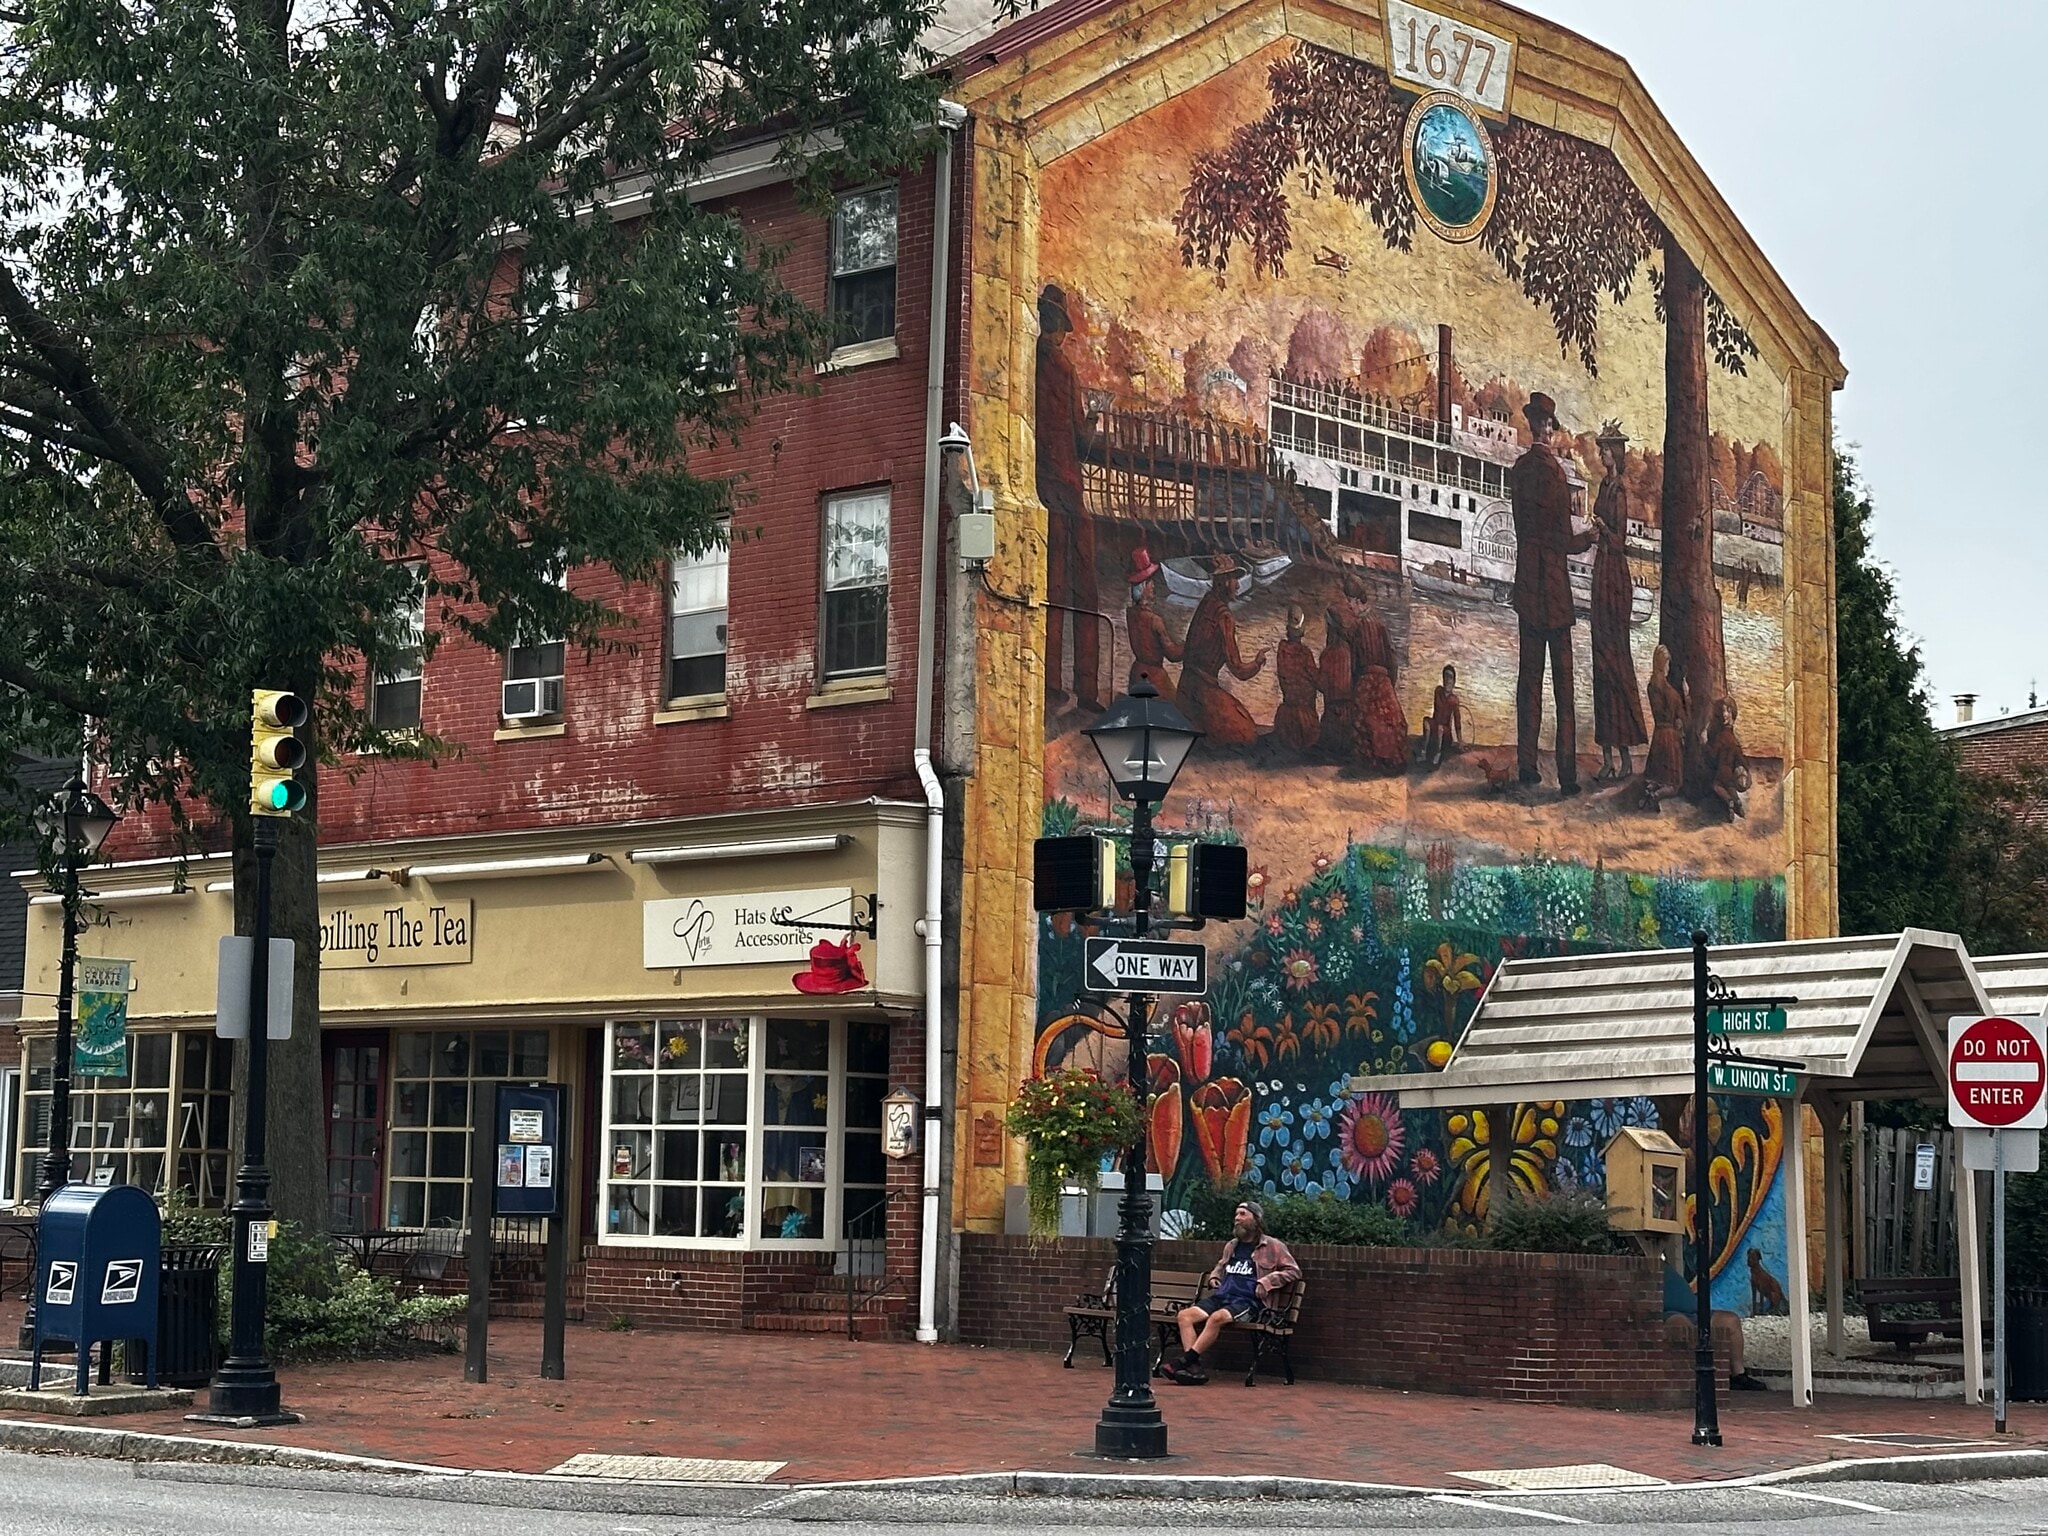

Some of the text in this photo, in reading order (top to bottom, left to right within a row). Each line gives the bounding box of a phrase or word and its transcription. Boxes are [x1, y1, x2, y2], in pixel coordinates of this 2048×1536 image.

[1405, 17, 1496, 96] 1677
[735, 908, 766, 926] Hats
[319, 906, 467, 963] pilling The Tea
[734, 929, 813, 948] Accessories
[1115, 955, 1194, 978] ONE WAY
[1723, 1011, 1771, 1030] HIGH ST.
[1964, 1040, 2031, 1056] DO NOT
[1714, 1067, 1791, 1092] W. UNION ST.
[1970, 1088, 2024, 1105] ENTER
